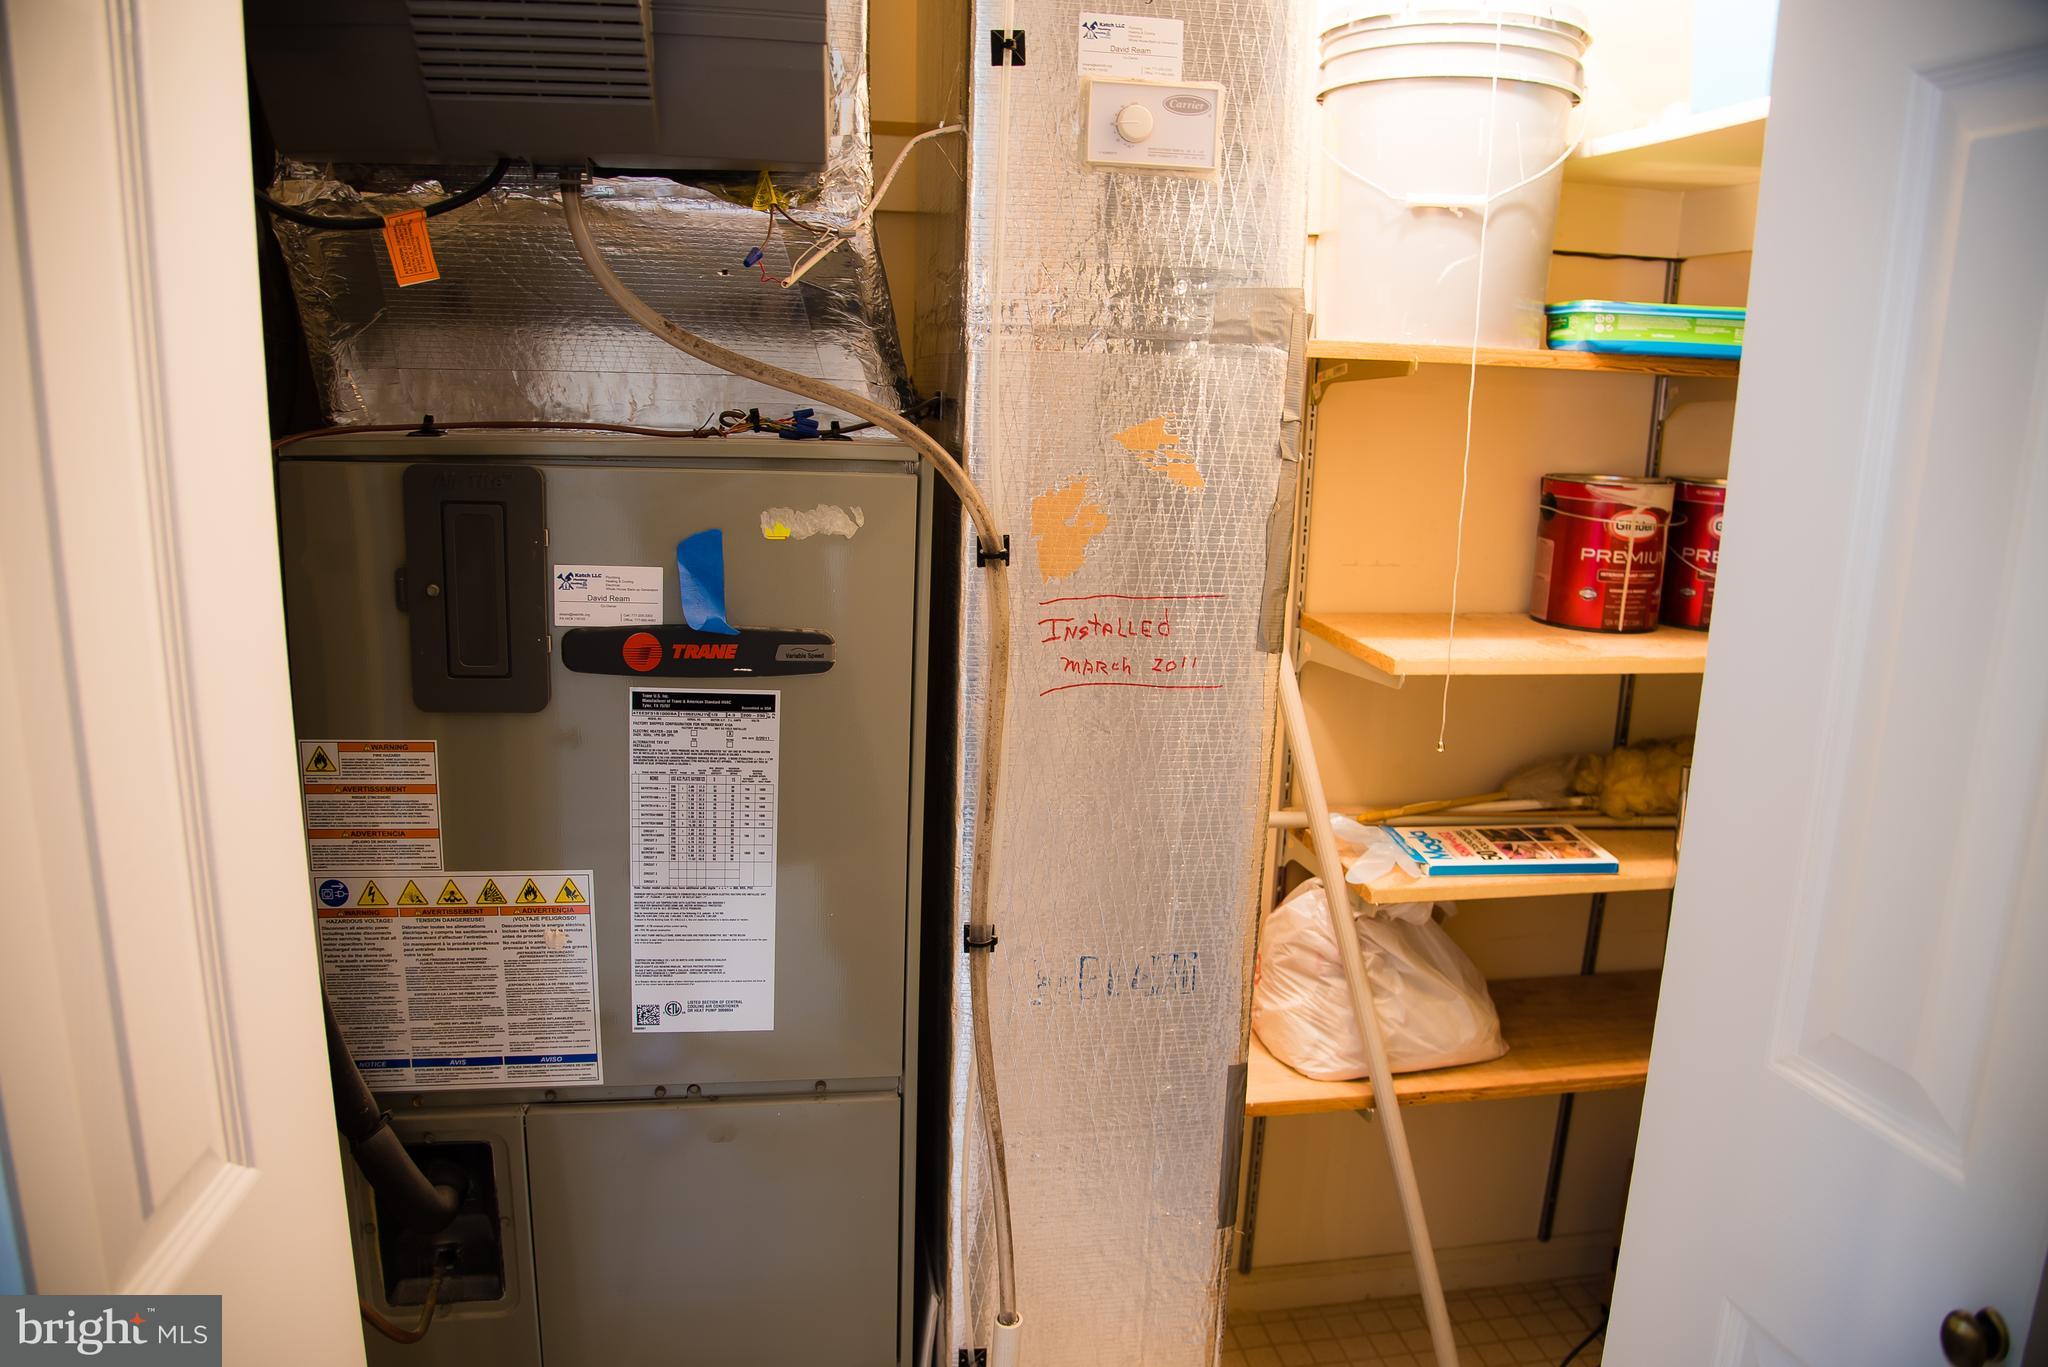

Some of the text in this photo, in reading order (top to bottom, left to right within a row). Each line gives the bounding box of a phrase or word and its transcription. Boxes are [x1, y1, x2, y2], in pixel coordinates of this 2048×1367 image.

[1110, 45, 1152, 55] David Ream
[1169, 99, 1204, 111] Carrier
[1581, 547, 1664, 565] PREMIU
[672, 644, 739, 660] TRANE
[1152, 656, 1198, 673] 2011
